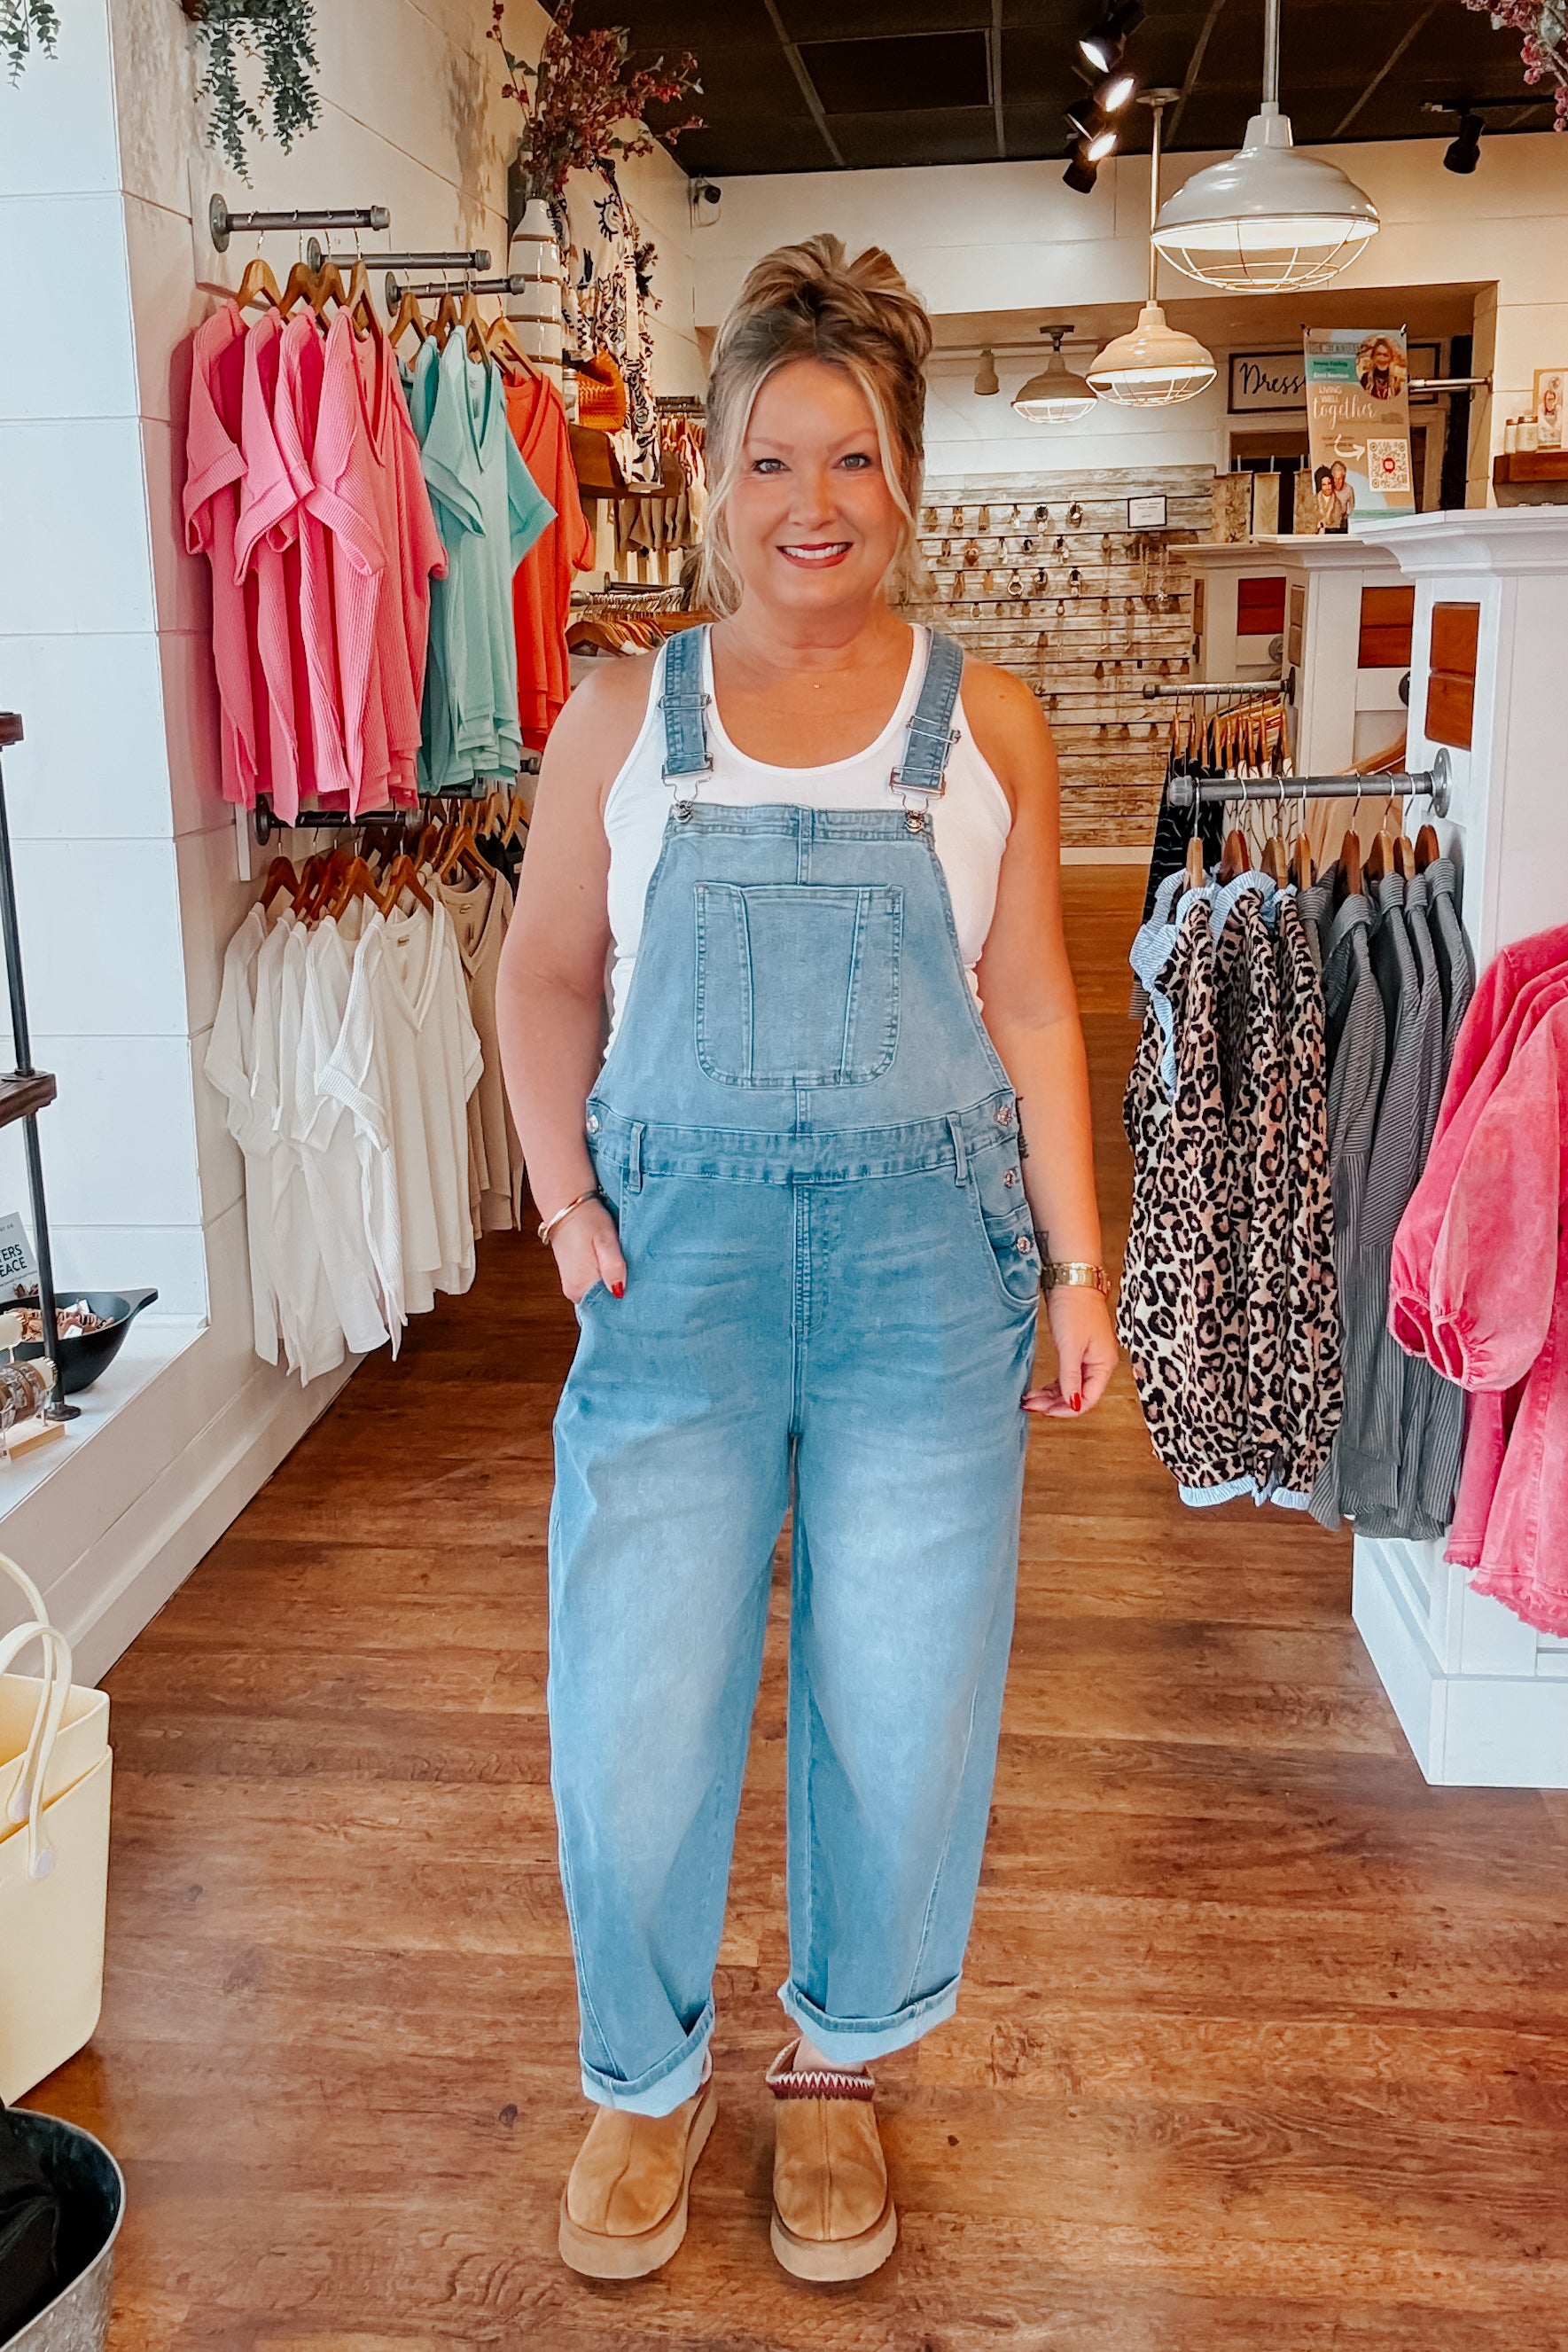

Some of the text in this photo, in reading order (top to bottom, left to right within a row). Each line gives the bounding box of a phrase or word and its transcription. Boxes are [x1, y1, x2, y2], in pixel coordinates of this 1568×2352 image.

[1239, 362, 1306, 395] Dress
[1318, 385, 1343, 395] LIVING
[1320, 395, 1339, 403] WELL
[1313, 395, 1377, 430] together
[0, 1244, 22, 1262] ERS
[0, 1256, 27, 1278] EACE
